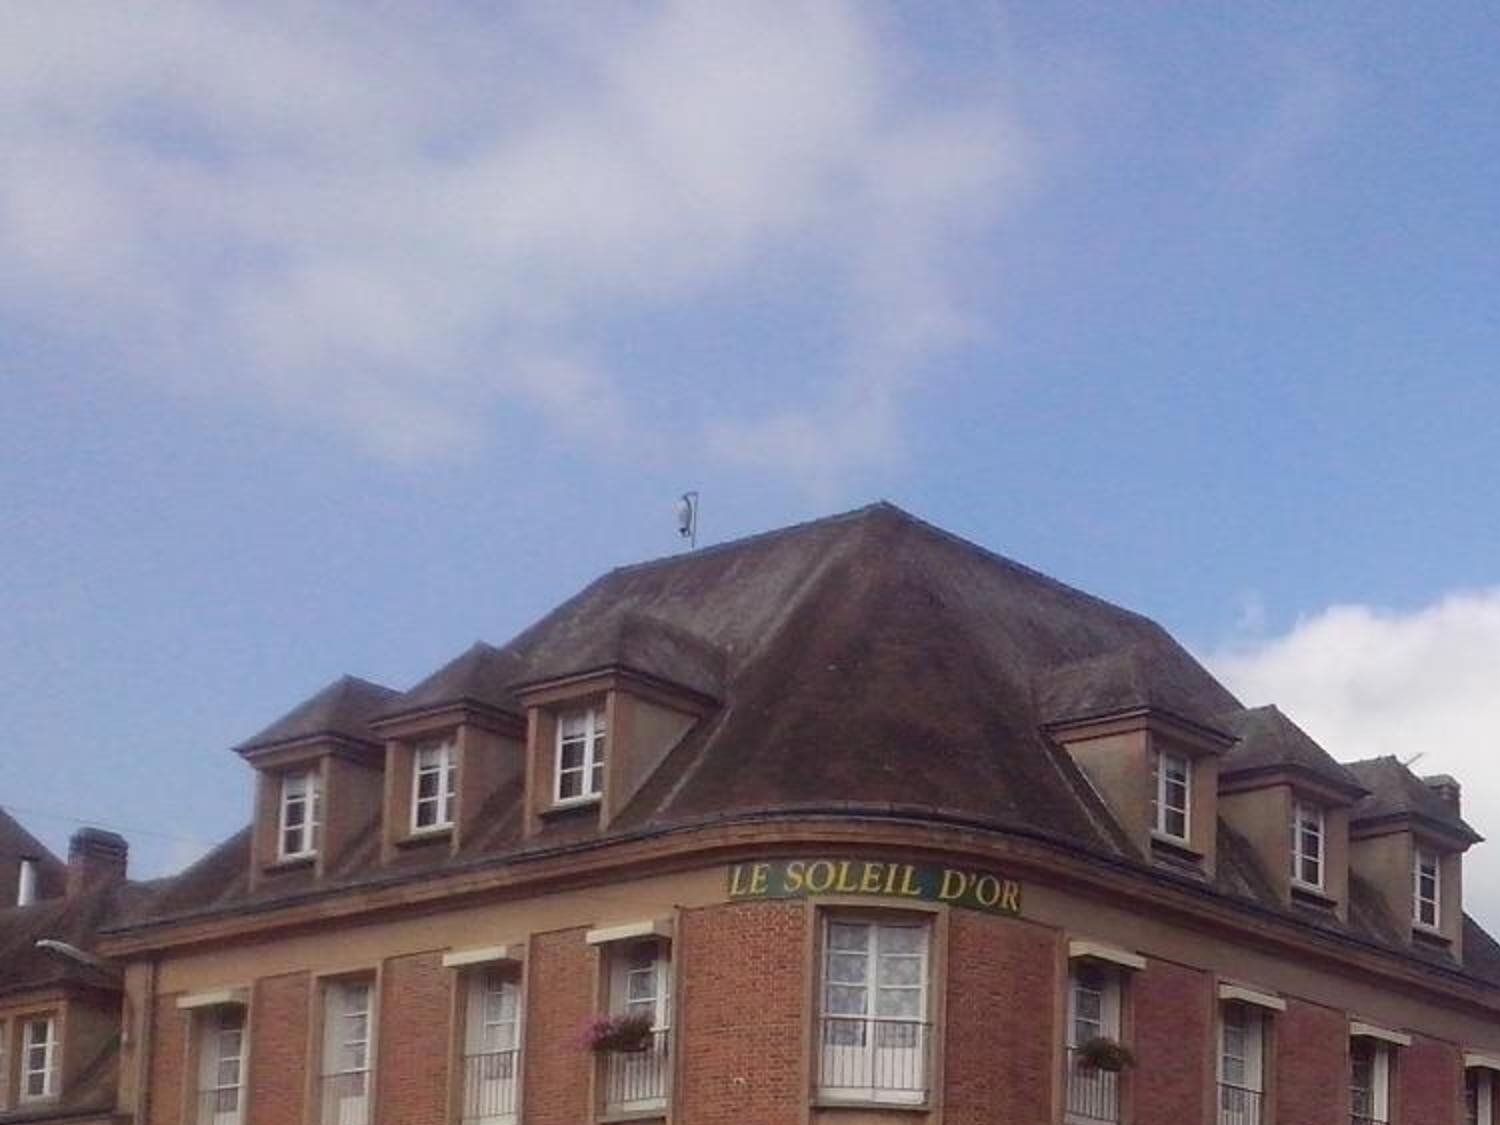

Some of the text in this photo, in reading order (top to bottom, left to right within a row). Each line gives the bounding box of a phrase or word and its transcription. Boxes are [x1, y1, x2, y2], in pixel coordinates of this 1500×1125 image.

[730, 860, 1020, 911] LE SOLEIL D'OR
